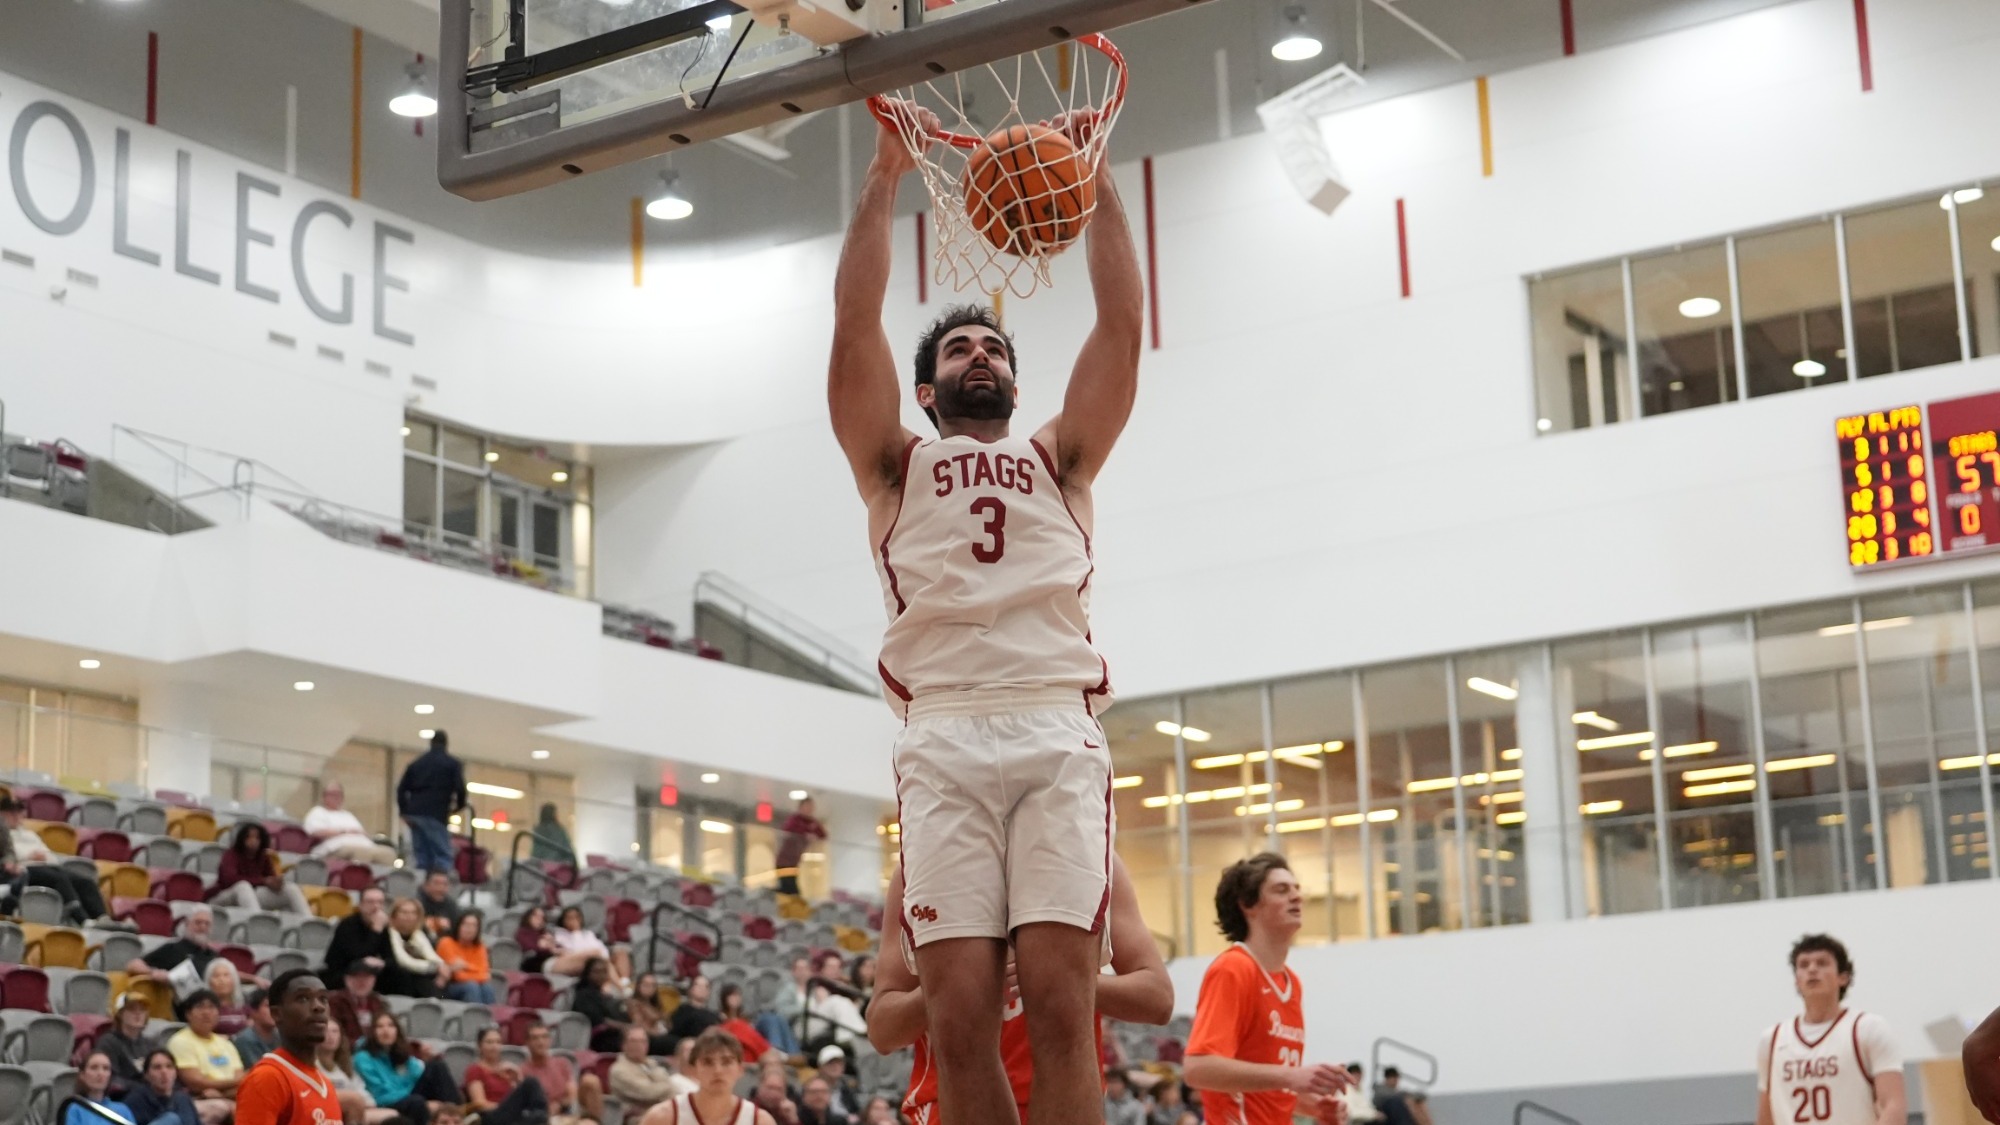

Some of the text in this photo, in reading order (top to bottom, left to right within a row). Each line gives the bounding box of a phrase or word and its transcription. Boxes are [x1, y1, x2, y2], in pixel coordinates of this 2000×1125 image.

[0, 90, 415, 346] OLLEGE
[933, 452, 1035, 497] STAGS
[970, 497, 1006, 564] 3
[1960, 503, 1981, 535] 0
[911, 904, 937, 922] CMS
[1783, 1055, 1839, 1082] STAGS
[1792, 1085, 1831, 1123] 20
